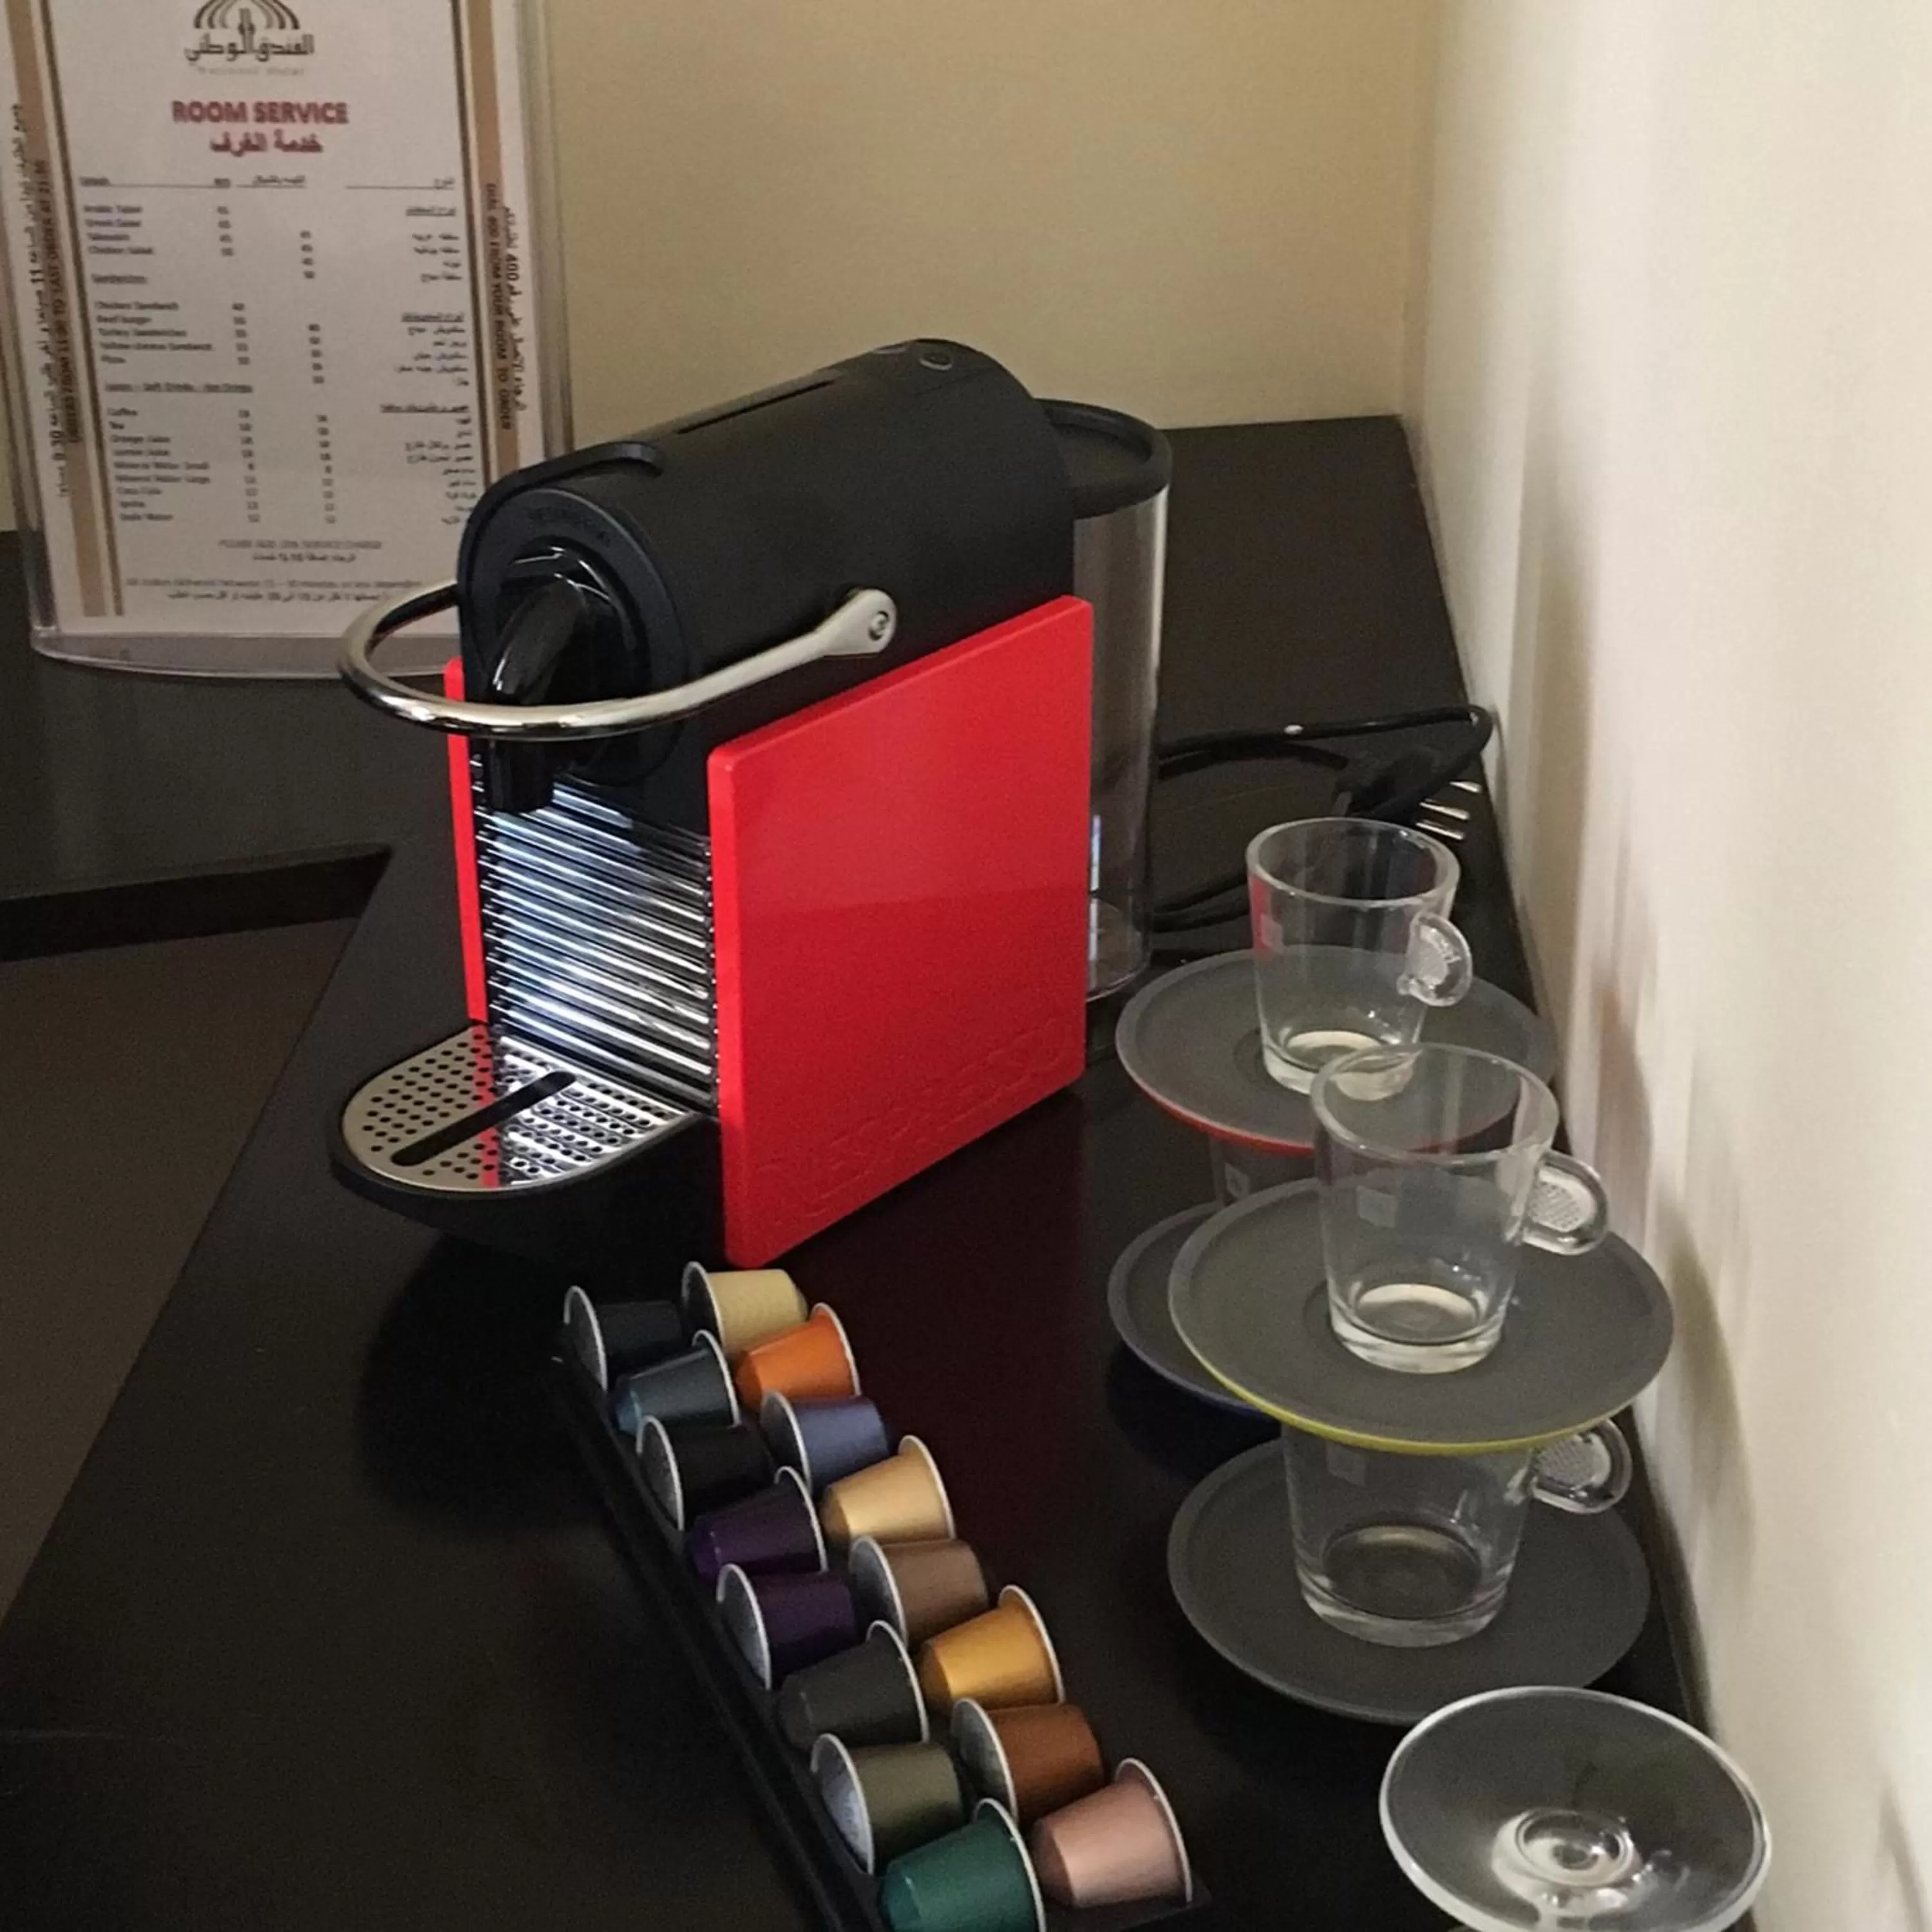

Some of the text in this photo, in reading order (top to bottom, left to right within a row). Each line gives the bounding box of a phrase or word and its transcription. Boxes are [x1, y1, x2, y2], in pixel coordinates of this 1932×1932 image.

[171, 100, 349, 124] ROOM SERVICE
[273, 129, 323, 153] خدمة
[28, 269, 44, 284] 11
[505, 253, 520, 281] 400
[49, 299, 65, 316] TO
[491, 283, 505, 315] YOUR
[494, 319, 509, 359] ROOM
[497, 366, 510, 383] TO
[498, 389, 513, 430] ORDER
